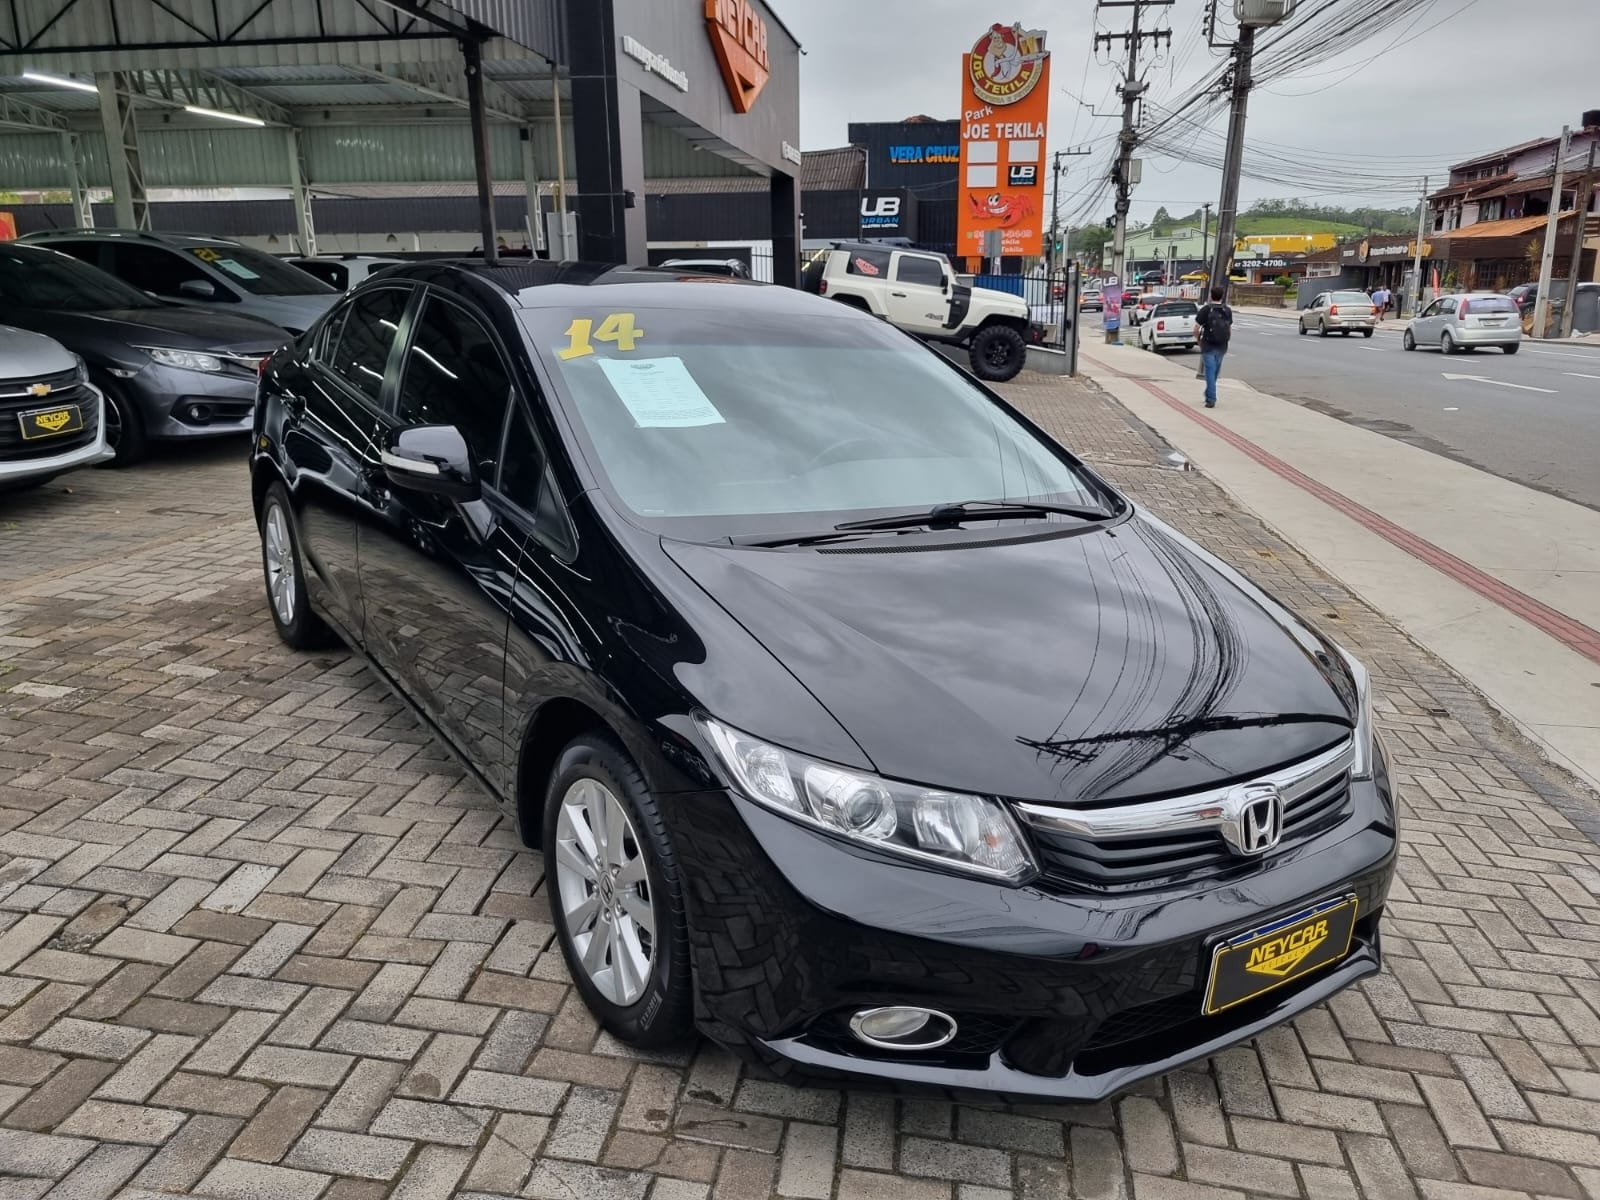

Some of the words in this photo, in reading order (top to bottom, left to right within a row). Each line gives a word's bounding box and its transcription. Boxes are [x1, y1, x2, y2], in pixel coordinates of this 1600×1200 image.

[973, 53, 985, 80] JOE
[984, 70, 1031, 95] TEKILA
[965, 105, 993, 122] Park
[963, 123, 990, 139] JOE
[995, 122, 1045, 138] TEKILA
[889, 146, 924, 163] VERA
[926, 145, 960, 163] CRUZ
[1010, 166, 1035, 178] UB
[861, 197, 900, 216] UB
[1241, 259, 1283, 267] 3202-4700
[559, 312, 644, 361] 14
[1245, 919, 1329, 969] NEYCAR
